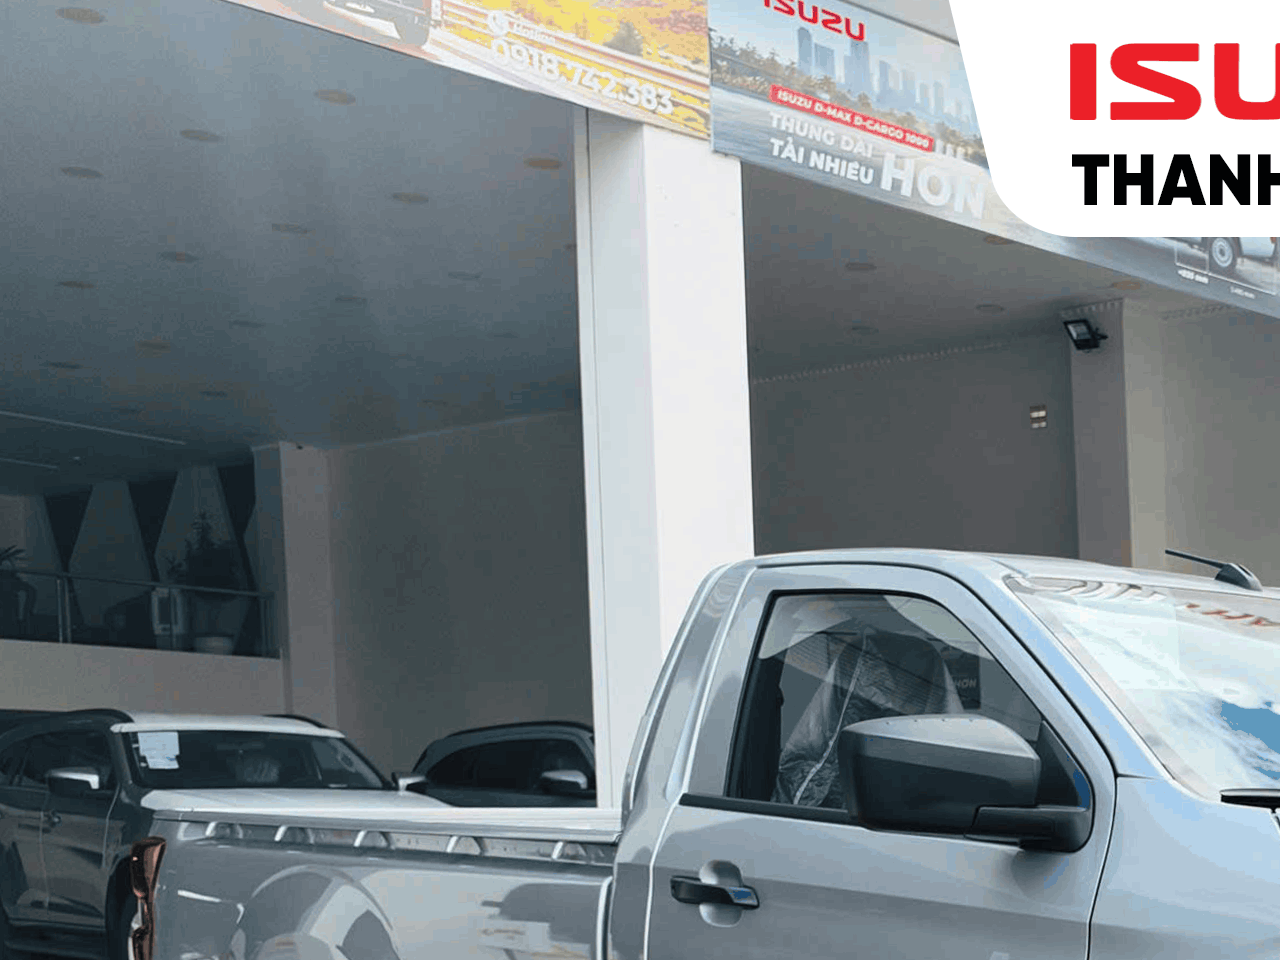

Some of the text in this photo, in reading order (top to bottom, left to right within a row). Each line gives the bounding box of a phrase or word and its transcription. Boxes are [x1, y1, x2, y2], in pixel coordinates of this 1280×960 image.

[490, 39, 674, 115] 0918.742.383
[777, 90, 930, 149] ISUZU D-MAX D-CARGO 1000
[769, 136, 804, 164] TẢI
